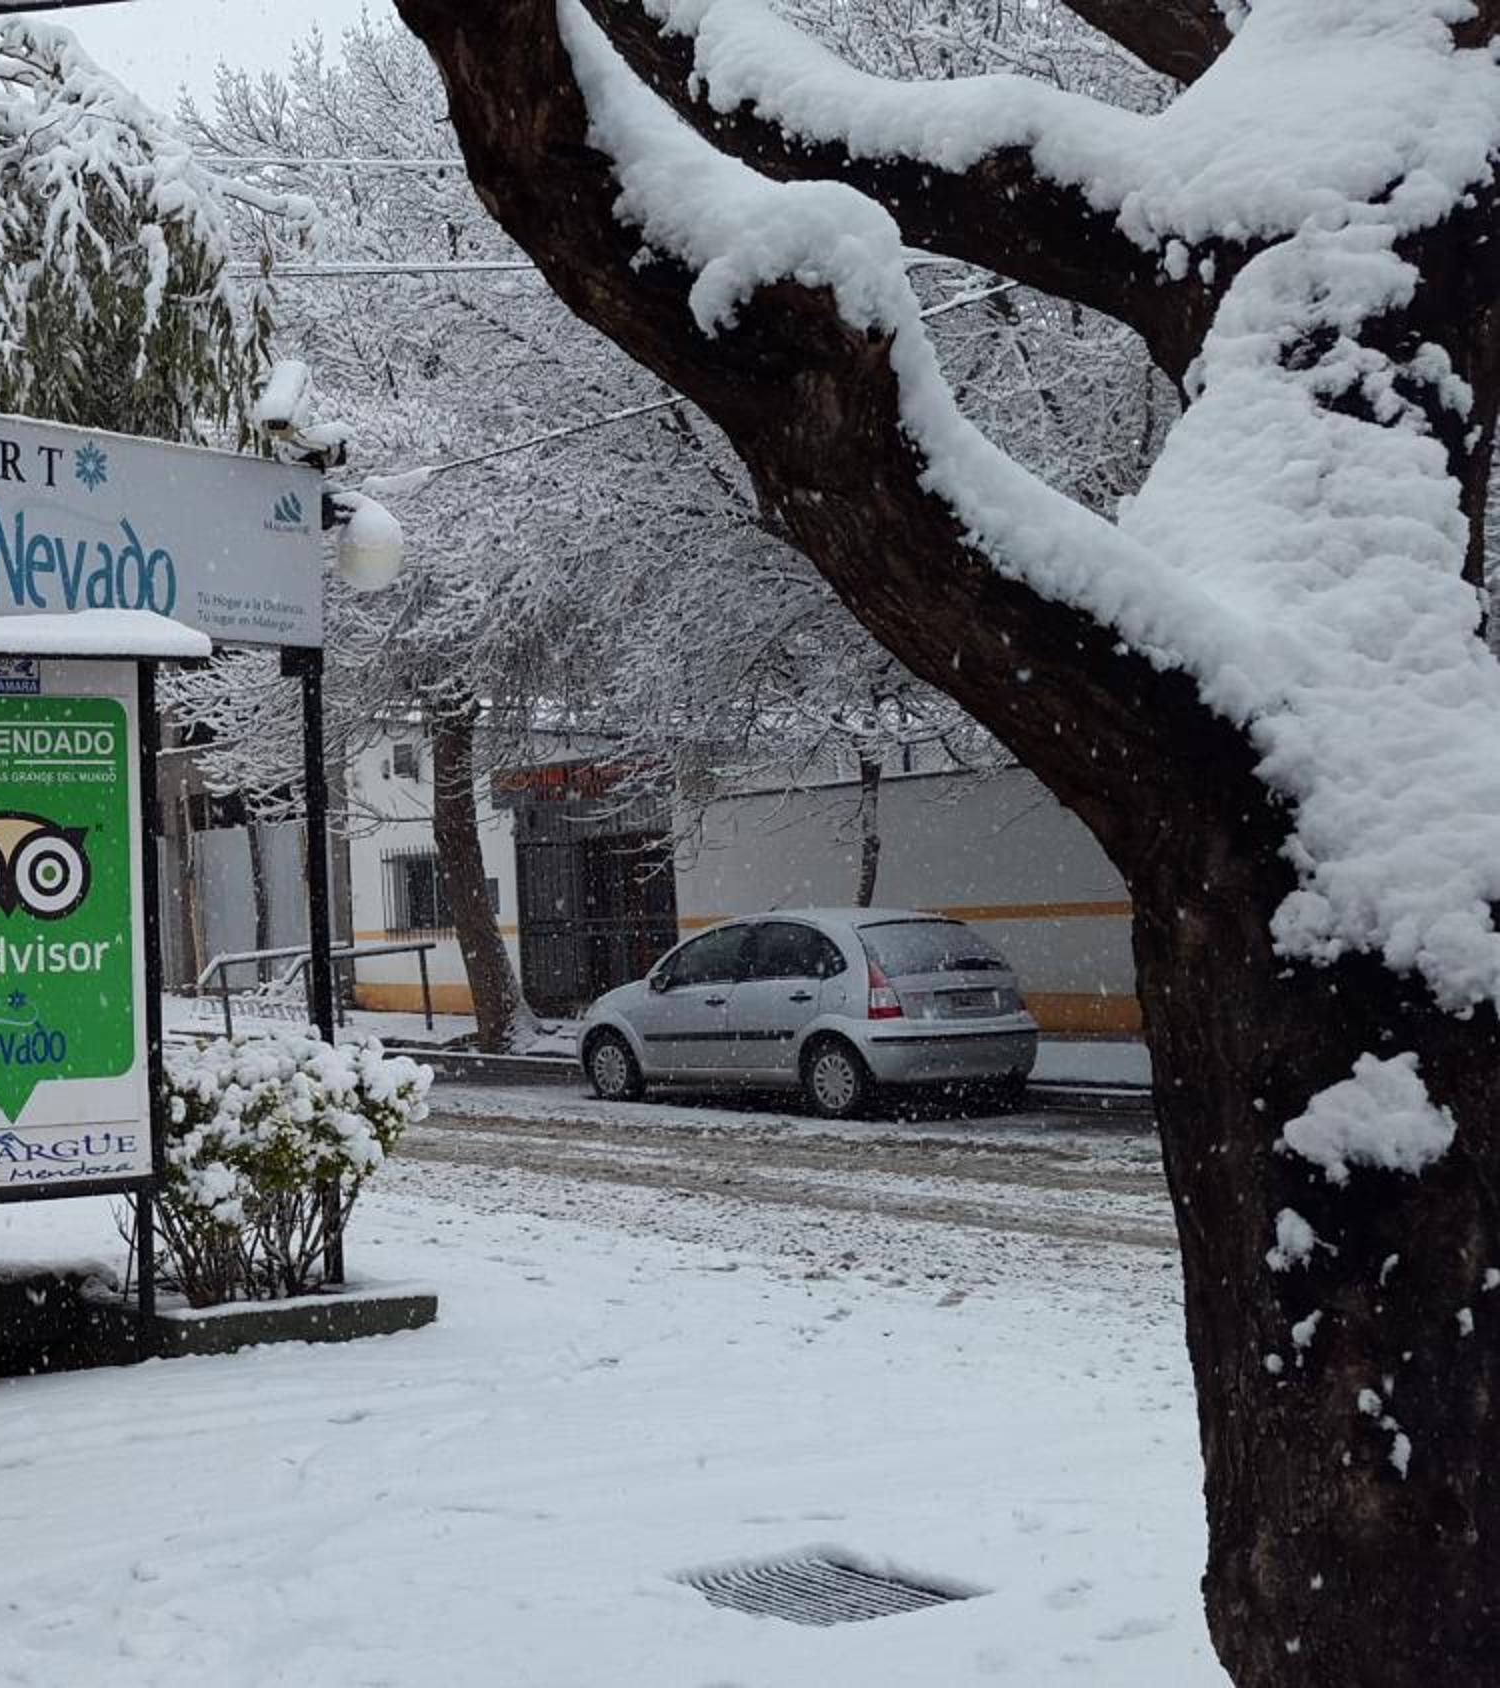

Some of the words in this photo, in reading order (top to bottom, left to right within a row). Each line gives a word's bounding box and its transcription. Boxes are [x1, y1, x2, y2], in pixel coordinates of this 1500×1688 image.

[11, 772, 53, 783] GRANDE
[57, 772, 76, 783] DEL
[79, 772, 117, 783] MUNDO
[9, 1160, 135, 1182] Mendoza
